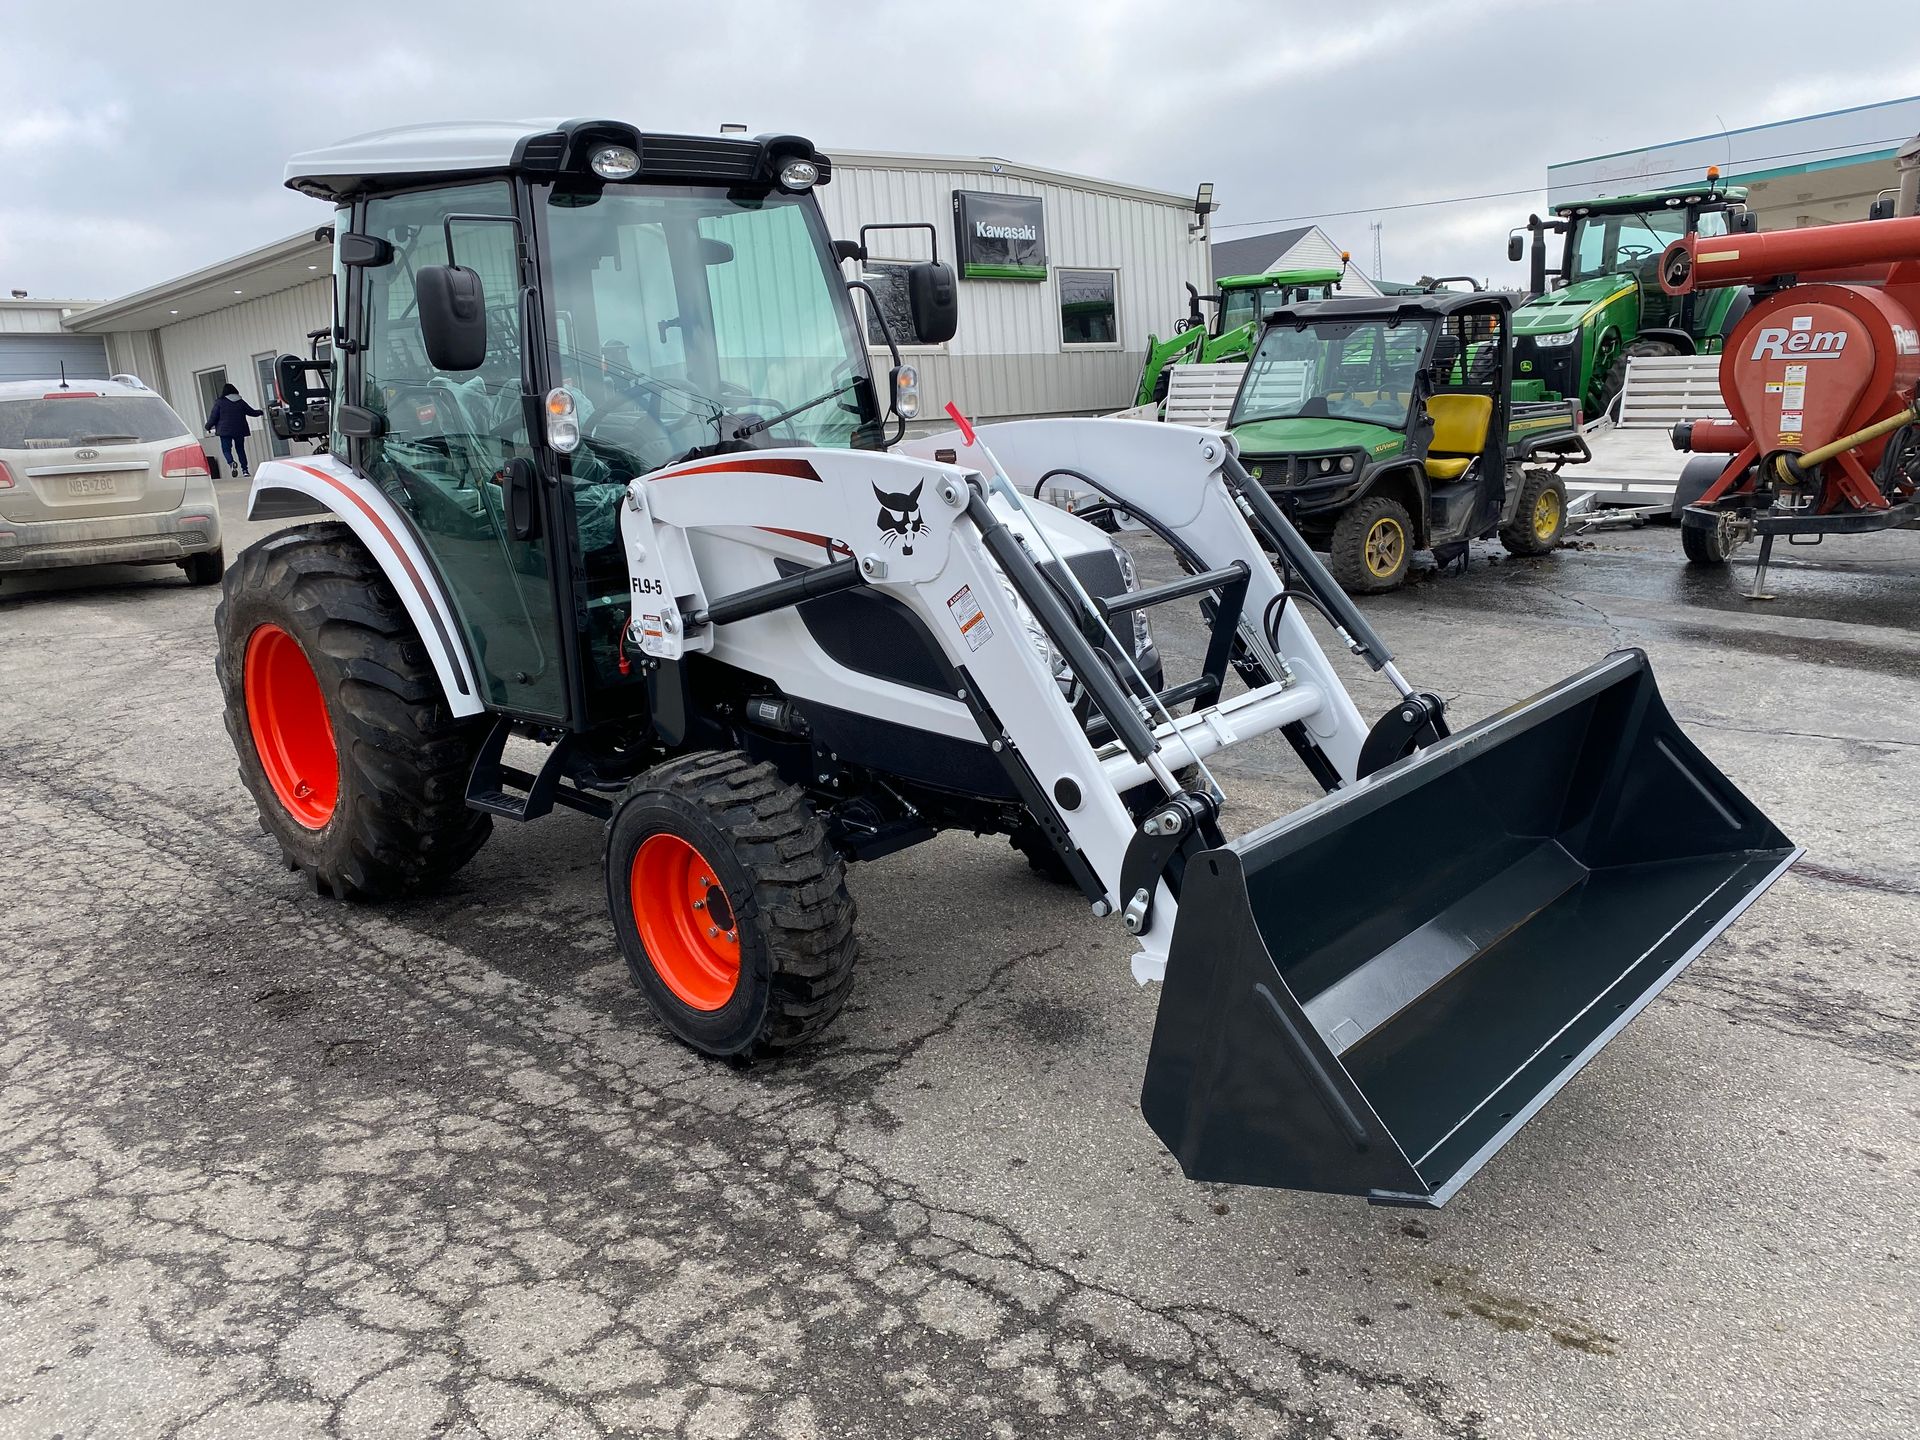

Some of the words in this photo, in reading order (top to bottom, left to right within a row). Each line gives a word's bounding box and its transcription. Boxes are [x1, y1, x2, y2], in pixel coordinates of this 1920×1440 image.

[976, 221, 1036, 240] Kawasaki
[1751, 328, 1848, 360] Rem
[631, 577, 663, 596] FL9-5
